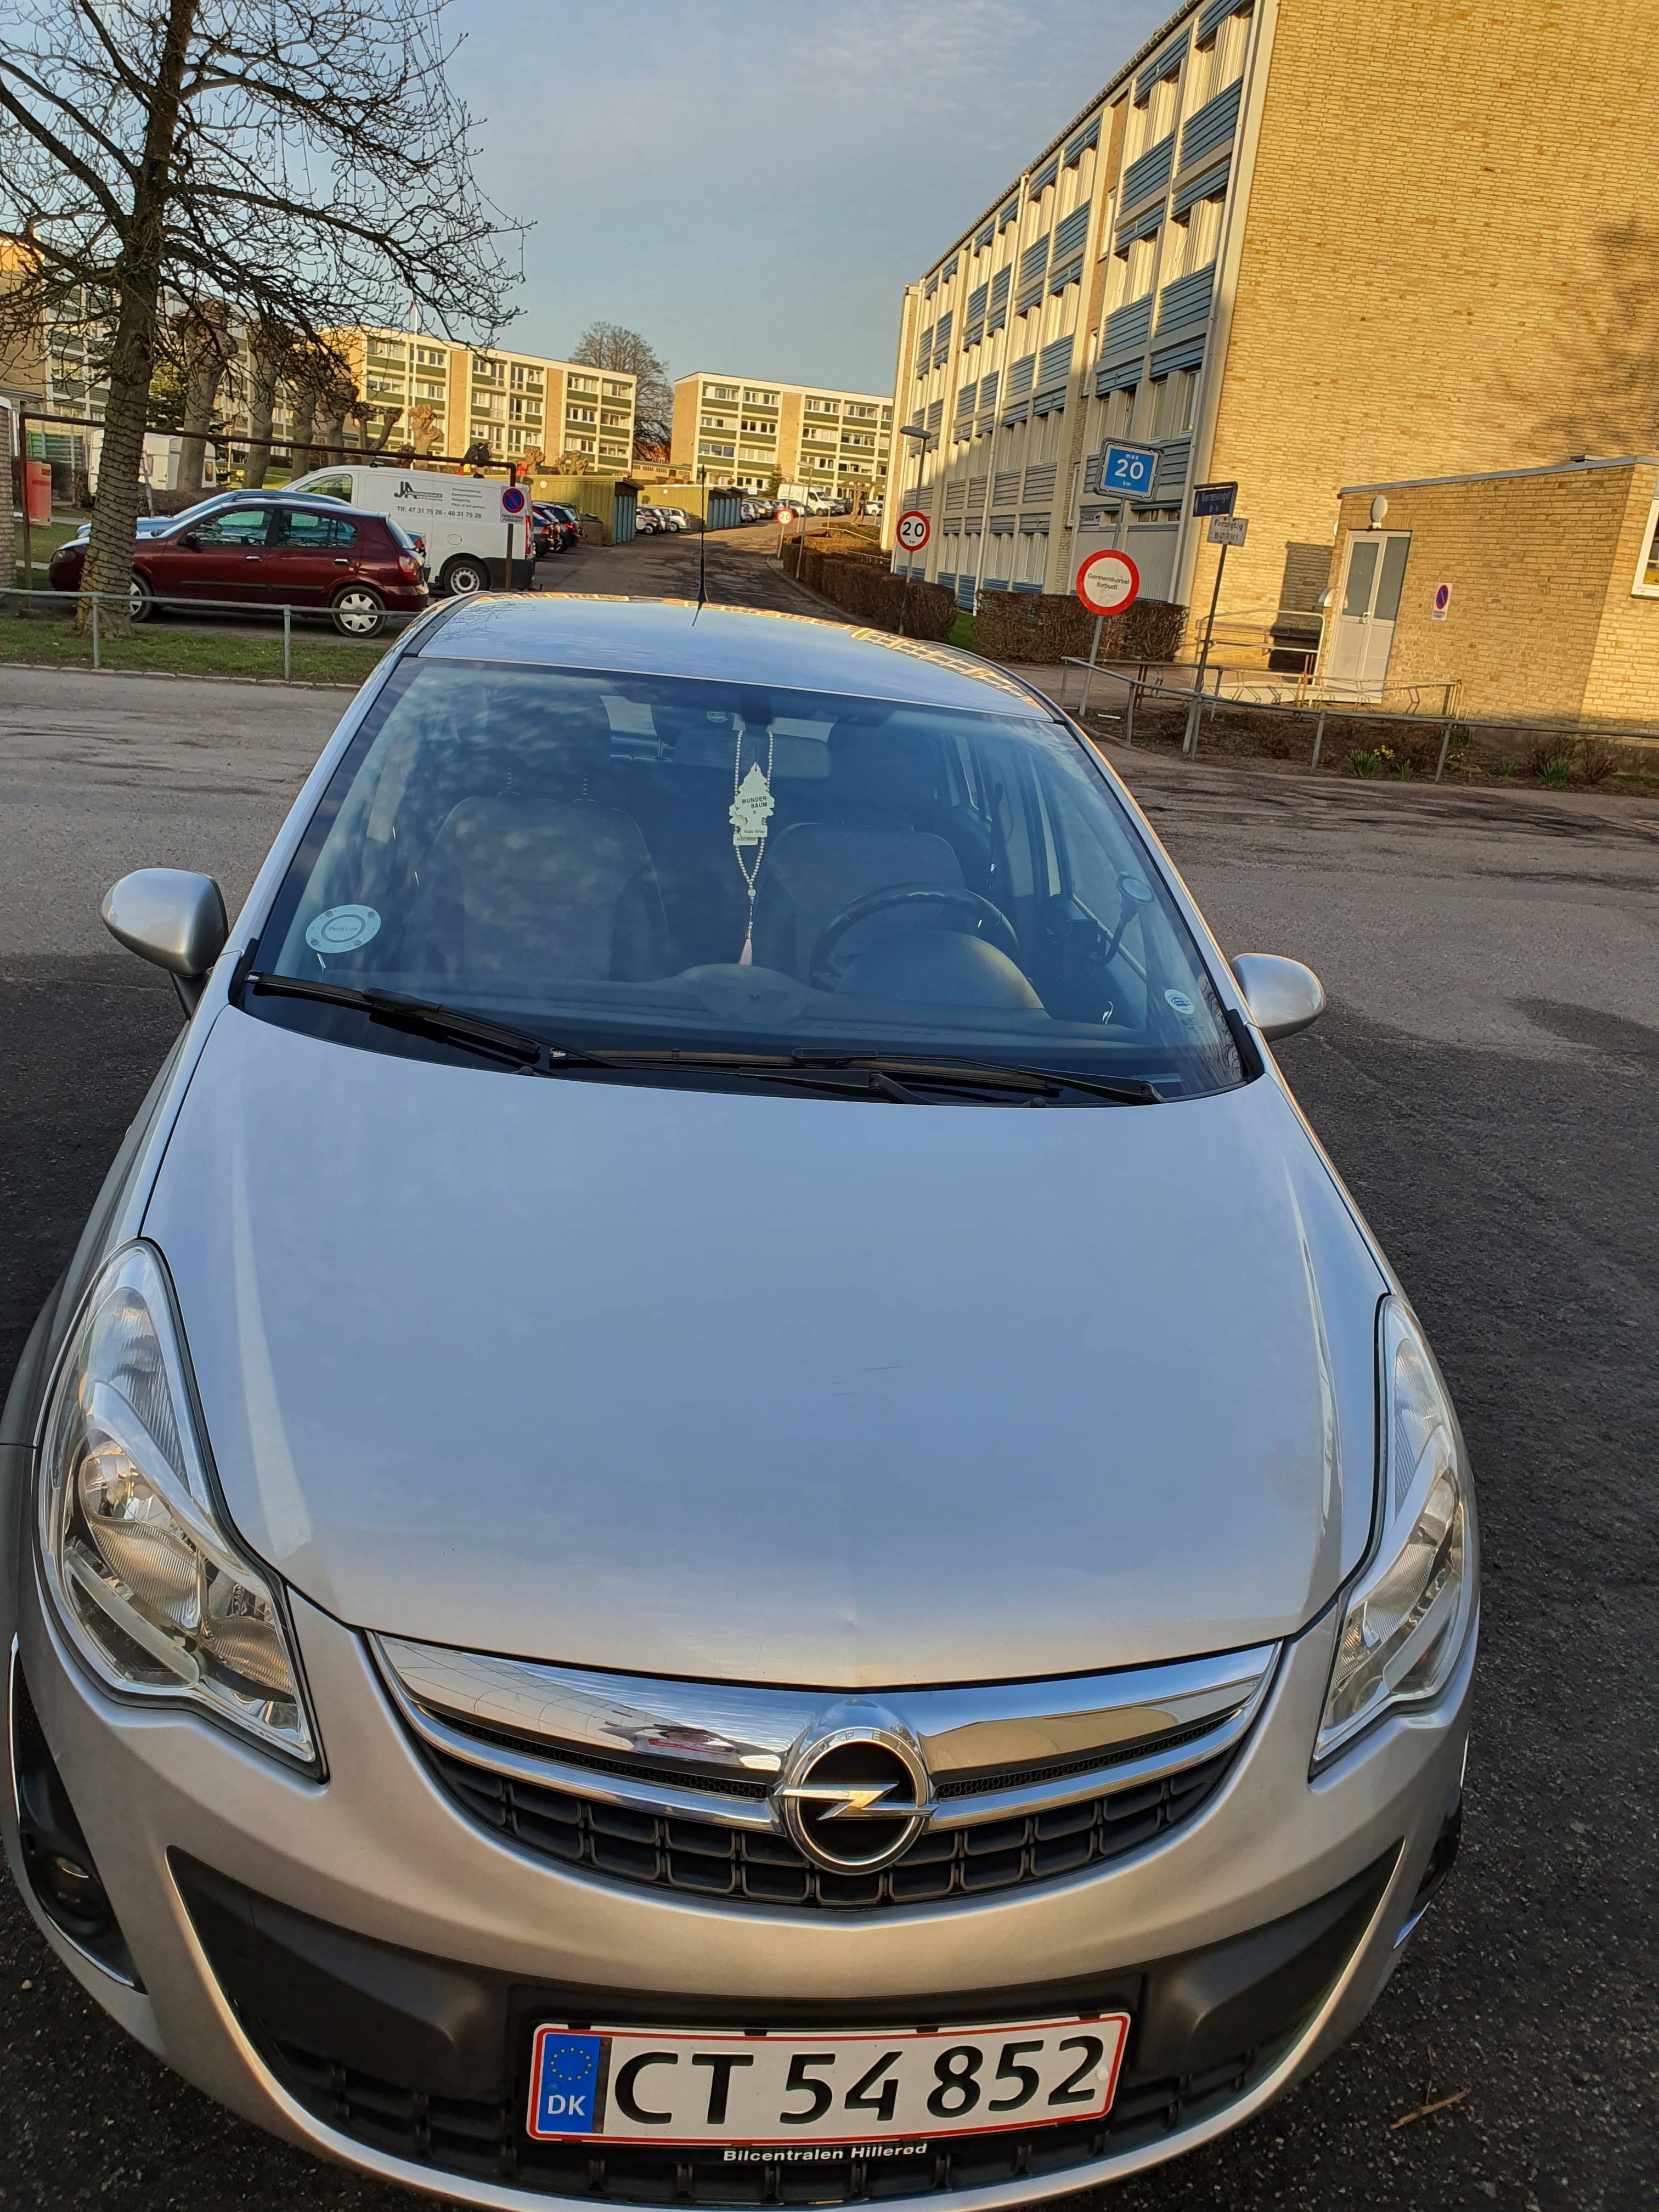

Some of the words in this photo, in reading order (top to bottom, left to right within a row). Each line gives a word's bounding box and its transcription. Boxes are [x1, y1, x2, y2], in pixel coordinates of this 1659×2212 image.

[1114, 459, 1144, 480] 20
[902, 521, 924, 537] 20
[1097, 582, 1118, 590] forbudt
[741, 796, 769, 804] WUNDER-
[817, 1730, 902, 1753] OPEL
[615, 2051, 754, 2124] CT
[780, 2051, 902, 2125] 54
[927, 2035, 1104, 2119] 852
[548, 2095, 586, 2117] DK
[723, 2148, 844, 2162] Bilcentralen
[851, 2143, 928, 2159] Hillerød
